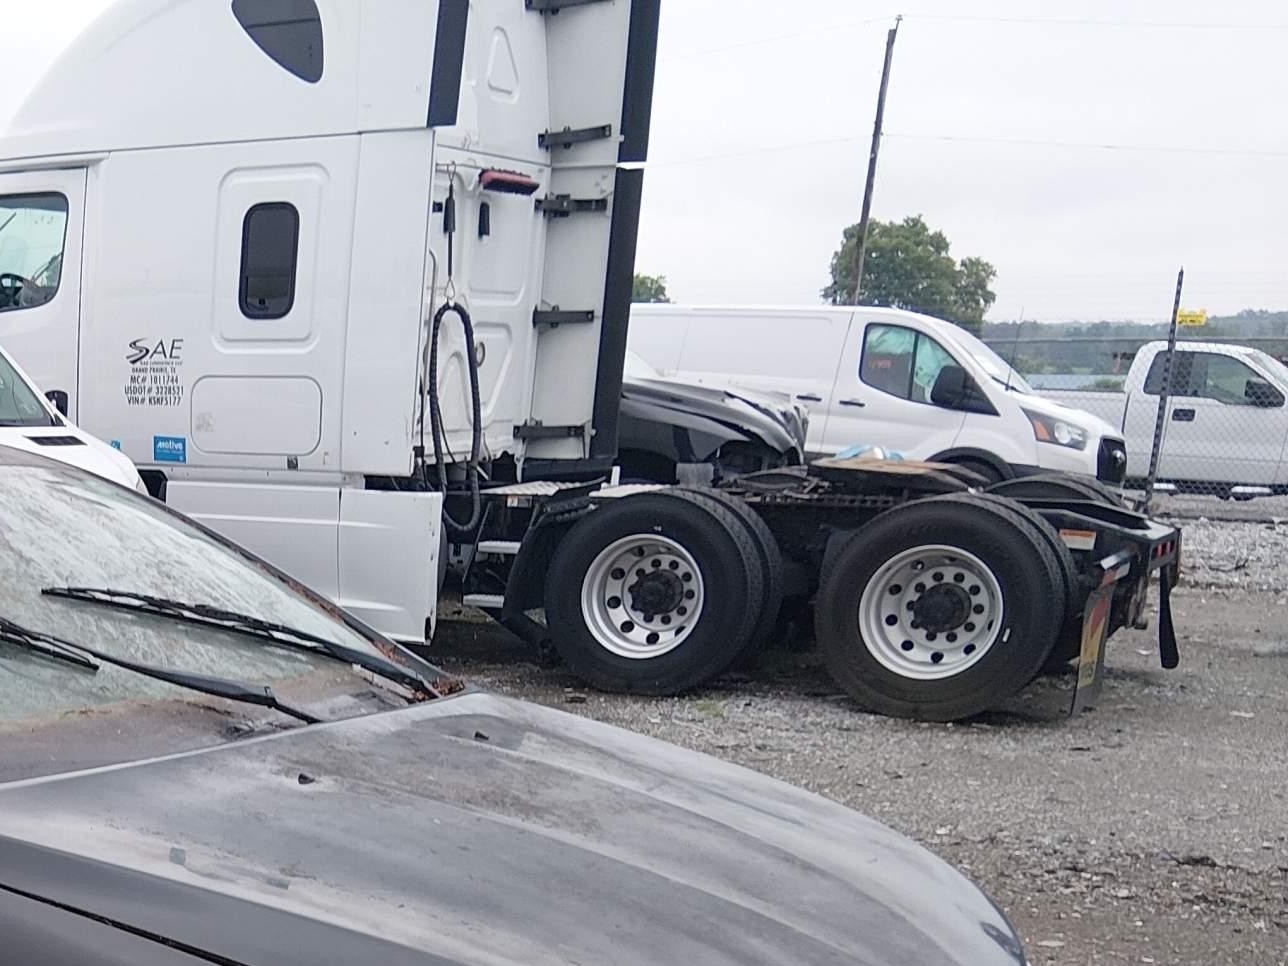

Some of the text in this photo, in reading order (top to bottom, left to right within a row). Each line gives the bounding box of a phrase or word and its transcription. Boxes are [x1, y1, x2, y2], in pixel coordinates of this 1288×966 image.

[126, 337, 184, 364] SAE
[130, 375, 147, 385] MC#
[124, 385, 152, 395] USDOT#
[127, 396, 145, 406] VIN#
